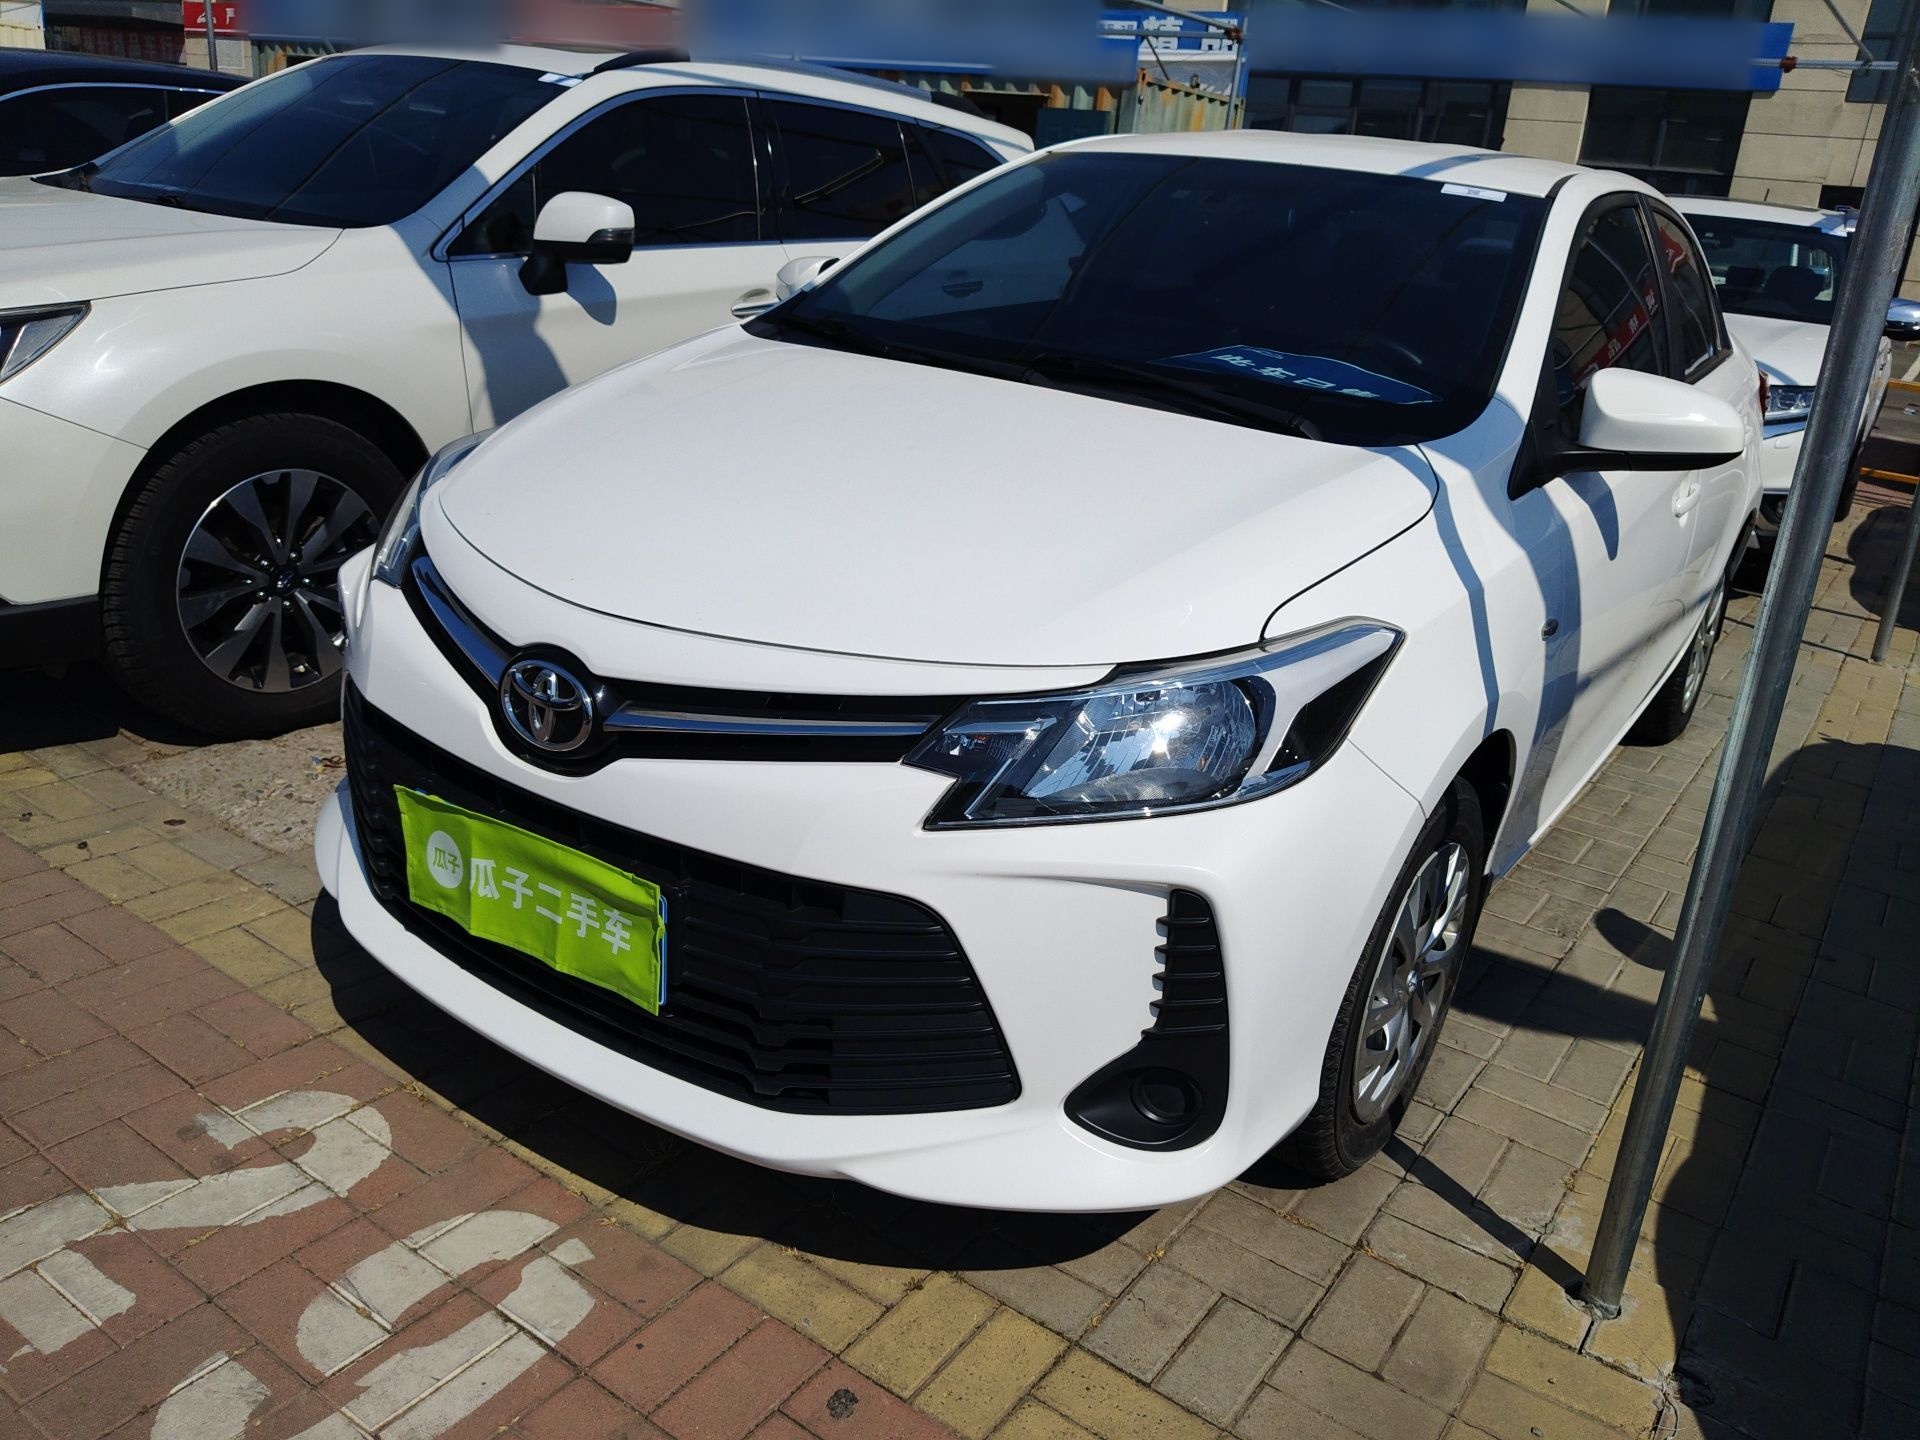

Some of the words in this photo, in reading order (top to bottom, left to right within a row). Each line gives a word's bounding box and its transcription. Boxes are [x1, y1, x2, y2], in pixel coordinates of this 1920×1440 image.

[432, 846, 461, 874] 瓜子
[469, 857, 633, 955] 瓜子二手车
